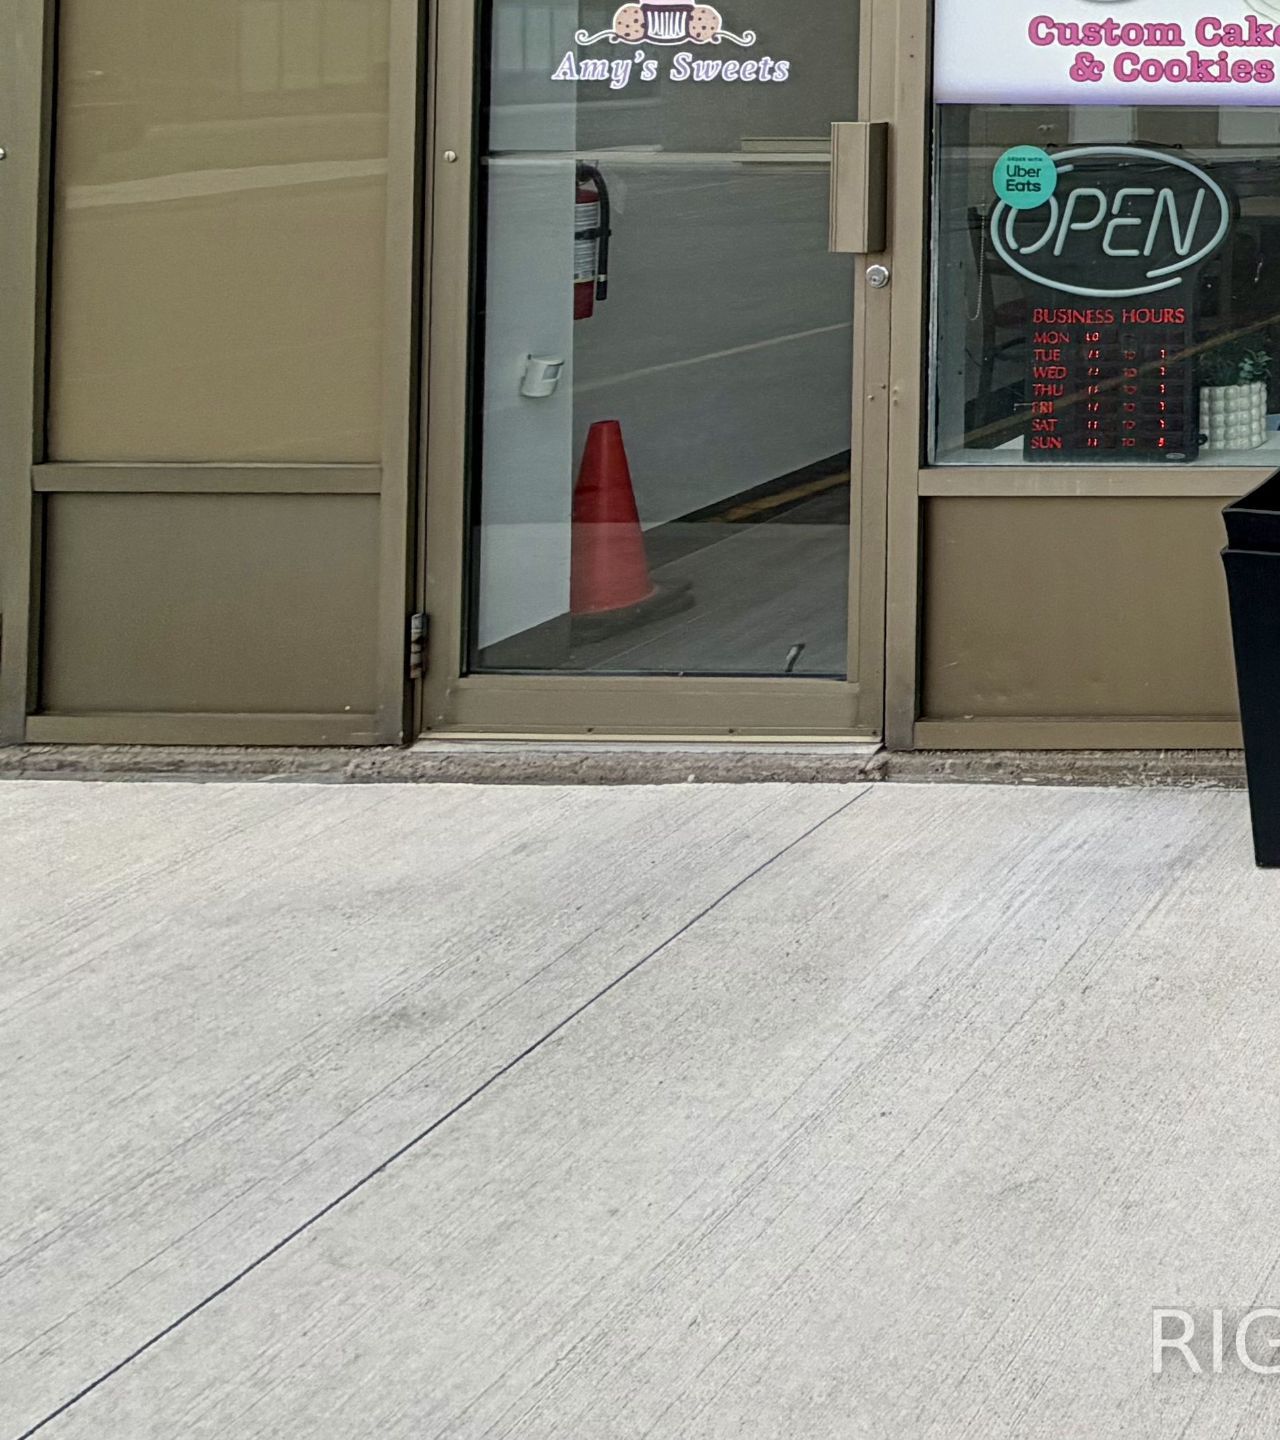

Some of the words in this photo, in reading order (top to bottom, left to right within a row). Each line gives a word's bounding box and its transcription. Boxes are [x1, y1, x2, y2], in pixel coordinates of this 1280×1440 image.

[1028, 15, 1186, 46] Custom
[551, 50, 659, 90] Amy's
[670, 51, 790, 82] Sweets
[1069, 51, 1106, 83] &
[1113, 50, 1276, 84] Cookies
[1006, 164, 1042, 178] Uber
[1006, 178, 1042, 192] Eats
[1005, 188, 1206, 257] OPEN
[1032, 308, 1115, 324] BUSINESS
[1122, 308, 1185, 324] HOURS
[1033, 331, 1071, 344] MON
[1032, 348, 1062, 362] TUE
[1032, 365, 1068, 380] WED
[1032, 383, 1064, 397] THU
[1031, 401, 1055, 414] FRI
[1031, 418, 1059, 431] SAT
[1030, 437, 1063, 449] SUN
